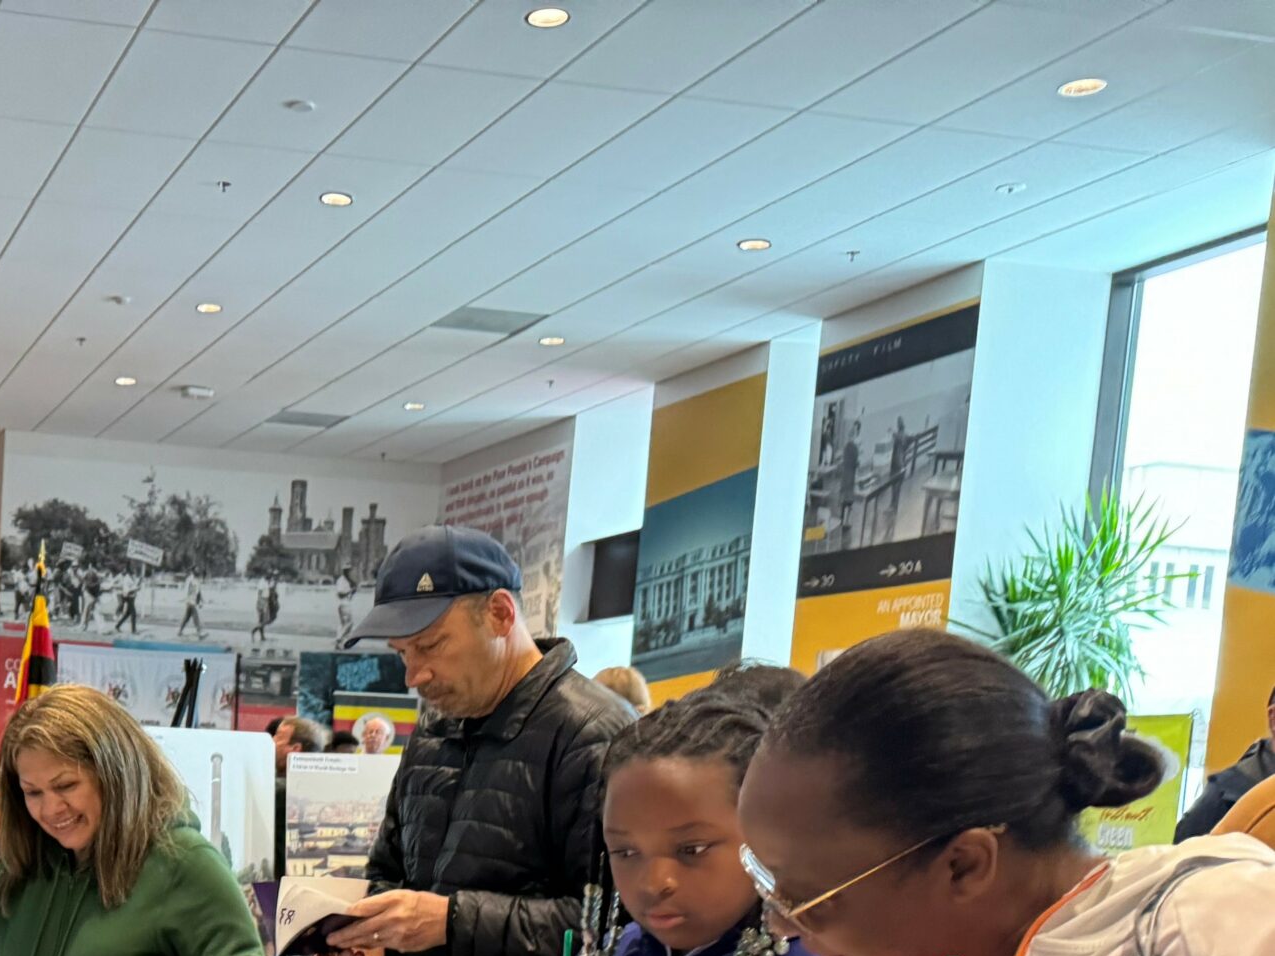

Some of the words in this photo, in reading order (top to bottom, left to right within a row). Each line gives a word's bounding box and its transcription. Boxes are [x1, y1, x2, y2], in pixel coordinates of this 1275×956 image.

[533, 450, 565, 468] Campaign
[877, 598, 891, 614] AN
[891, 593, 944, 612] APPOINTED
[899, 609, 942, 628] MAYOR
